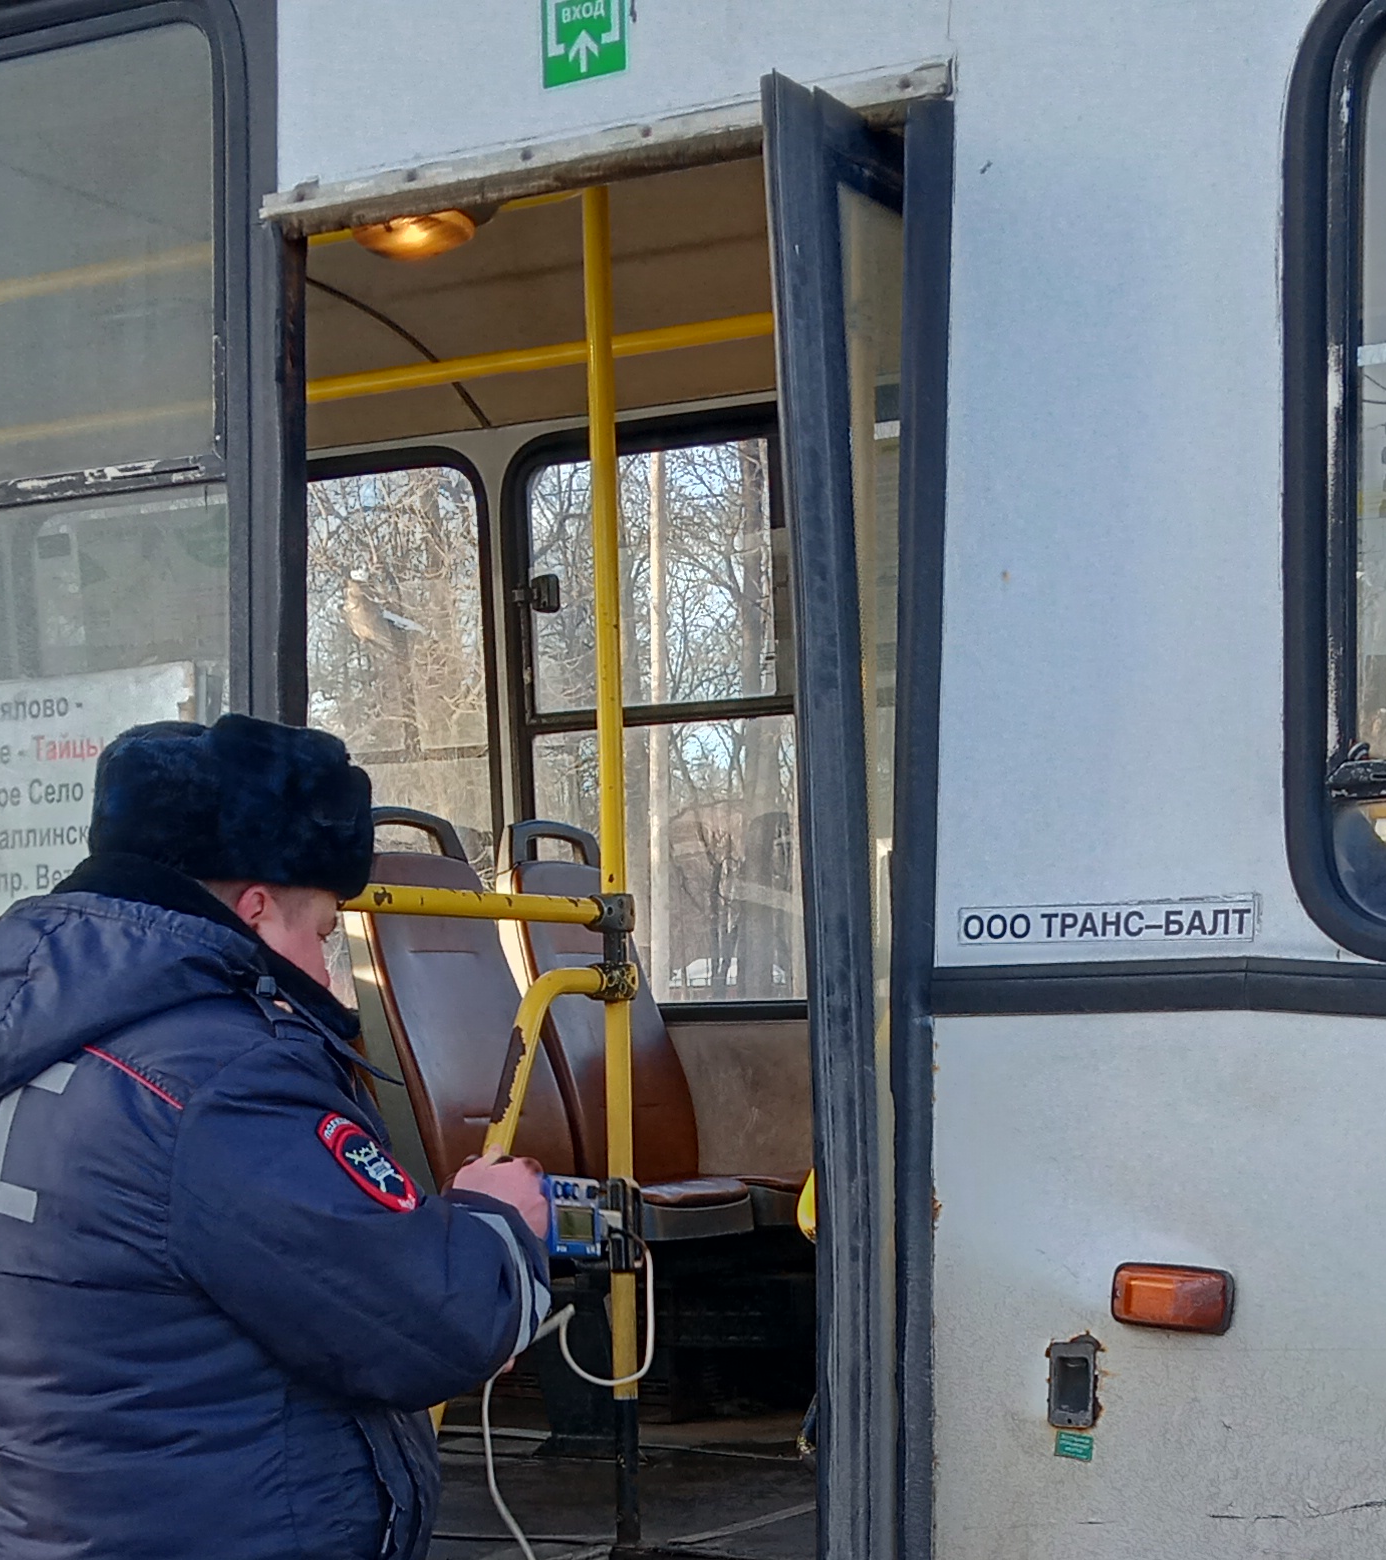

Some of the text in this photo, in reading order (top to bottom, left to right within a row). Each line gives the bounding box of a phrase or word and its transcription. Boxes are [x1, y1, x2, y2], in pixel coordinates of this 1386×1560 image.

[561, 0, 606, 24] ВХОД
[32, 731, 104, 762] Тайцы
[28, 777, 84, 805] Село
[964, 908, 1251, 939] ООО ТРАНС-БАЛТ
